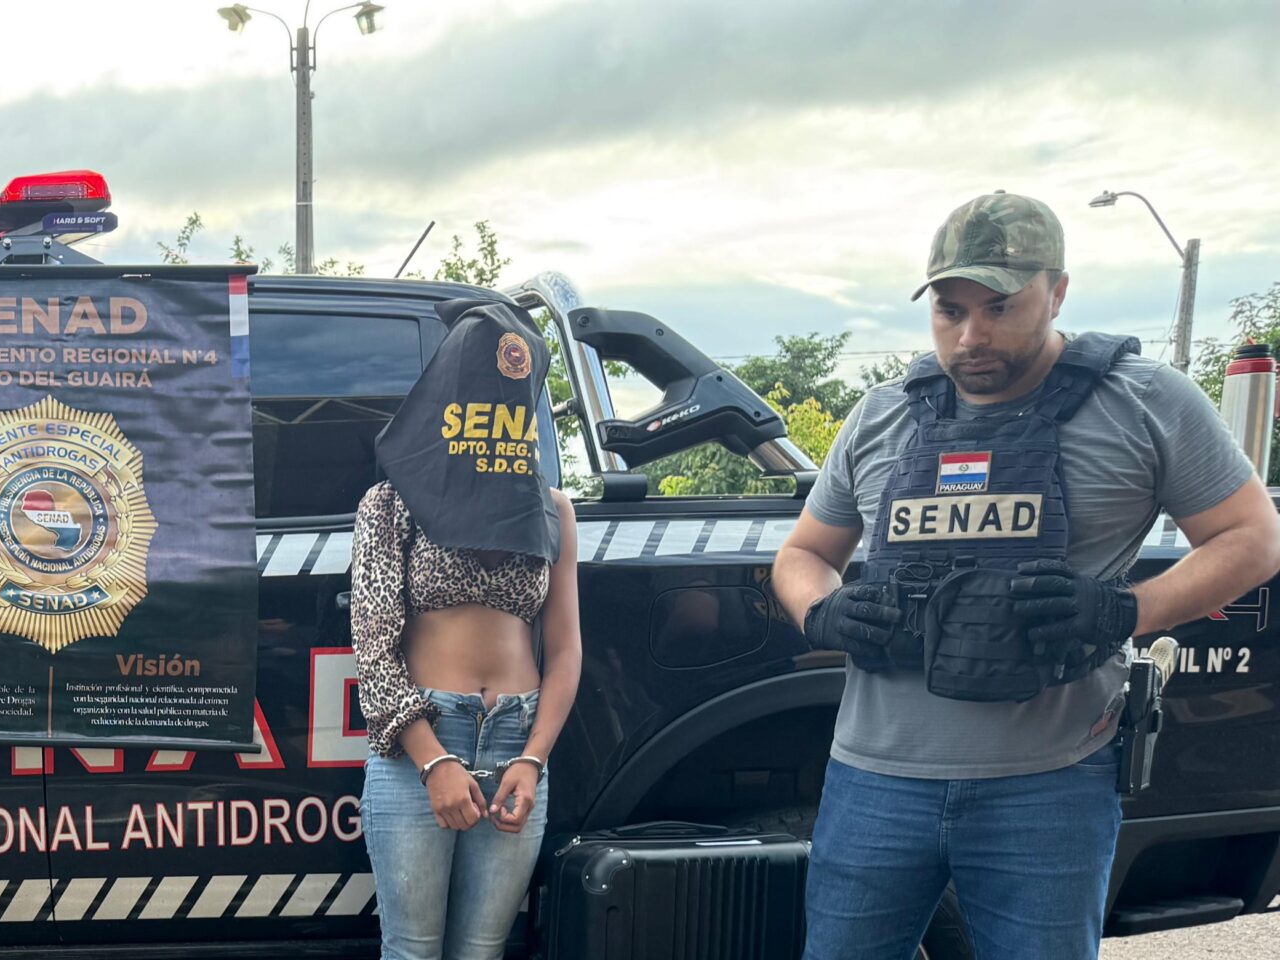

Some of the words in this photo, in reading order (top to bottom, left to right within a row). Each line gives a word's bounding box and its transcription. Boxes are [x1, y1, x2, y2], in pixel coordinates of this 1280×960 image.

[63, 349, 176, 366] REGIONAL
[18, 372, 62, 387] DEL
[68, 369, 152, 388] GUAIRÁ
[45, 423, 121, 462] ESPECIAL
[448, 441, 490, 455] DPTO.
[495, 441, 531, 457] REG.
[3, 446, 100, 471] ANTIDROGAS
[476, 458, 533, 475] S.D.G.
[0, 471, 41, 512] PRESIDENCIA
[42, 469, 54, 479] DE
[57, 469, 68, 480] LA
[70, 475, 104, 515] REPÚBLICA
[939, 483, 984, 492] PARAGUAY
[36, 513, 69, 524] SENAD
[892, 501, 1036, 536] SENAD
[18, 592, 88, 610] SENAD
[115, 653, 201, 677] Visión
[1236, 647, 1251, 673] 2
[14, 685, 24, 693] de
[28, 685, 36, 694] la
[105, 683, 142, 693] profesional
[187, 685, 238, 695] comprometida
[7, 696, 36, 706] Drogas
[0, 708, 34, 716] sociedad.
